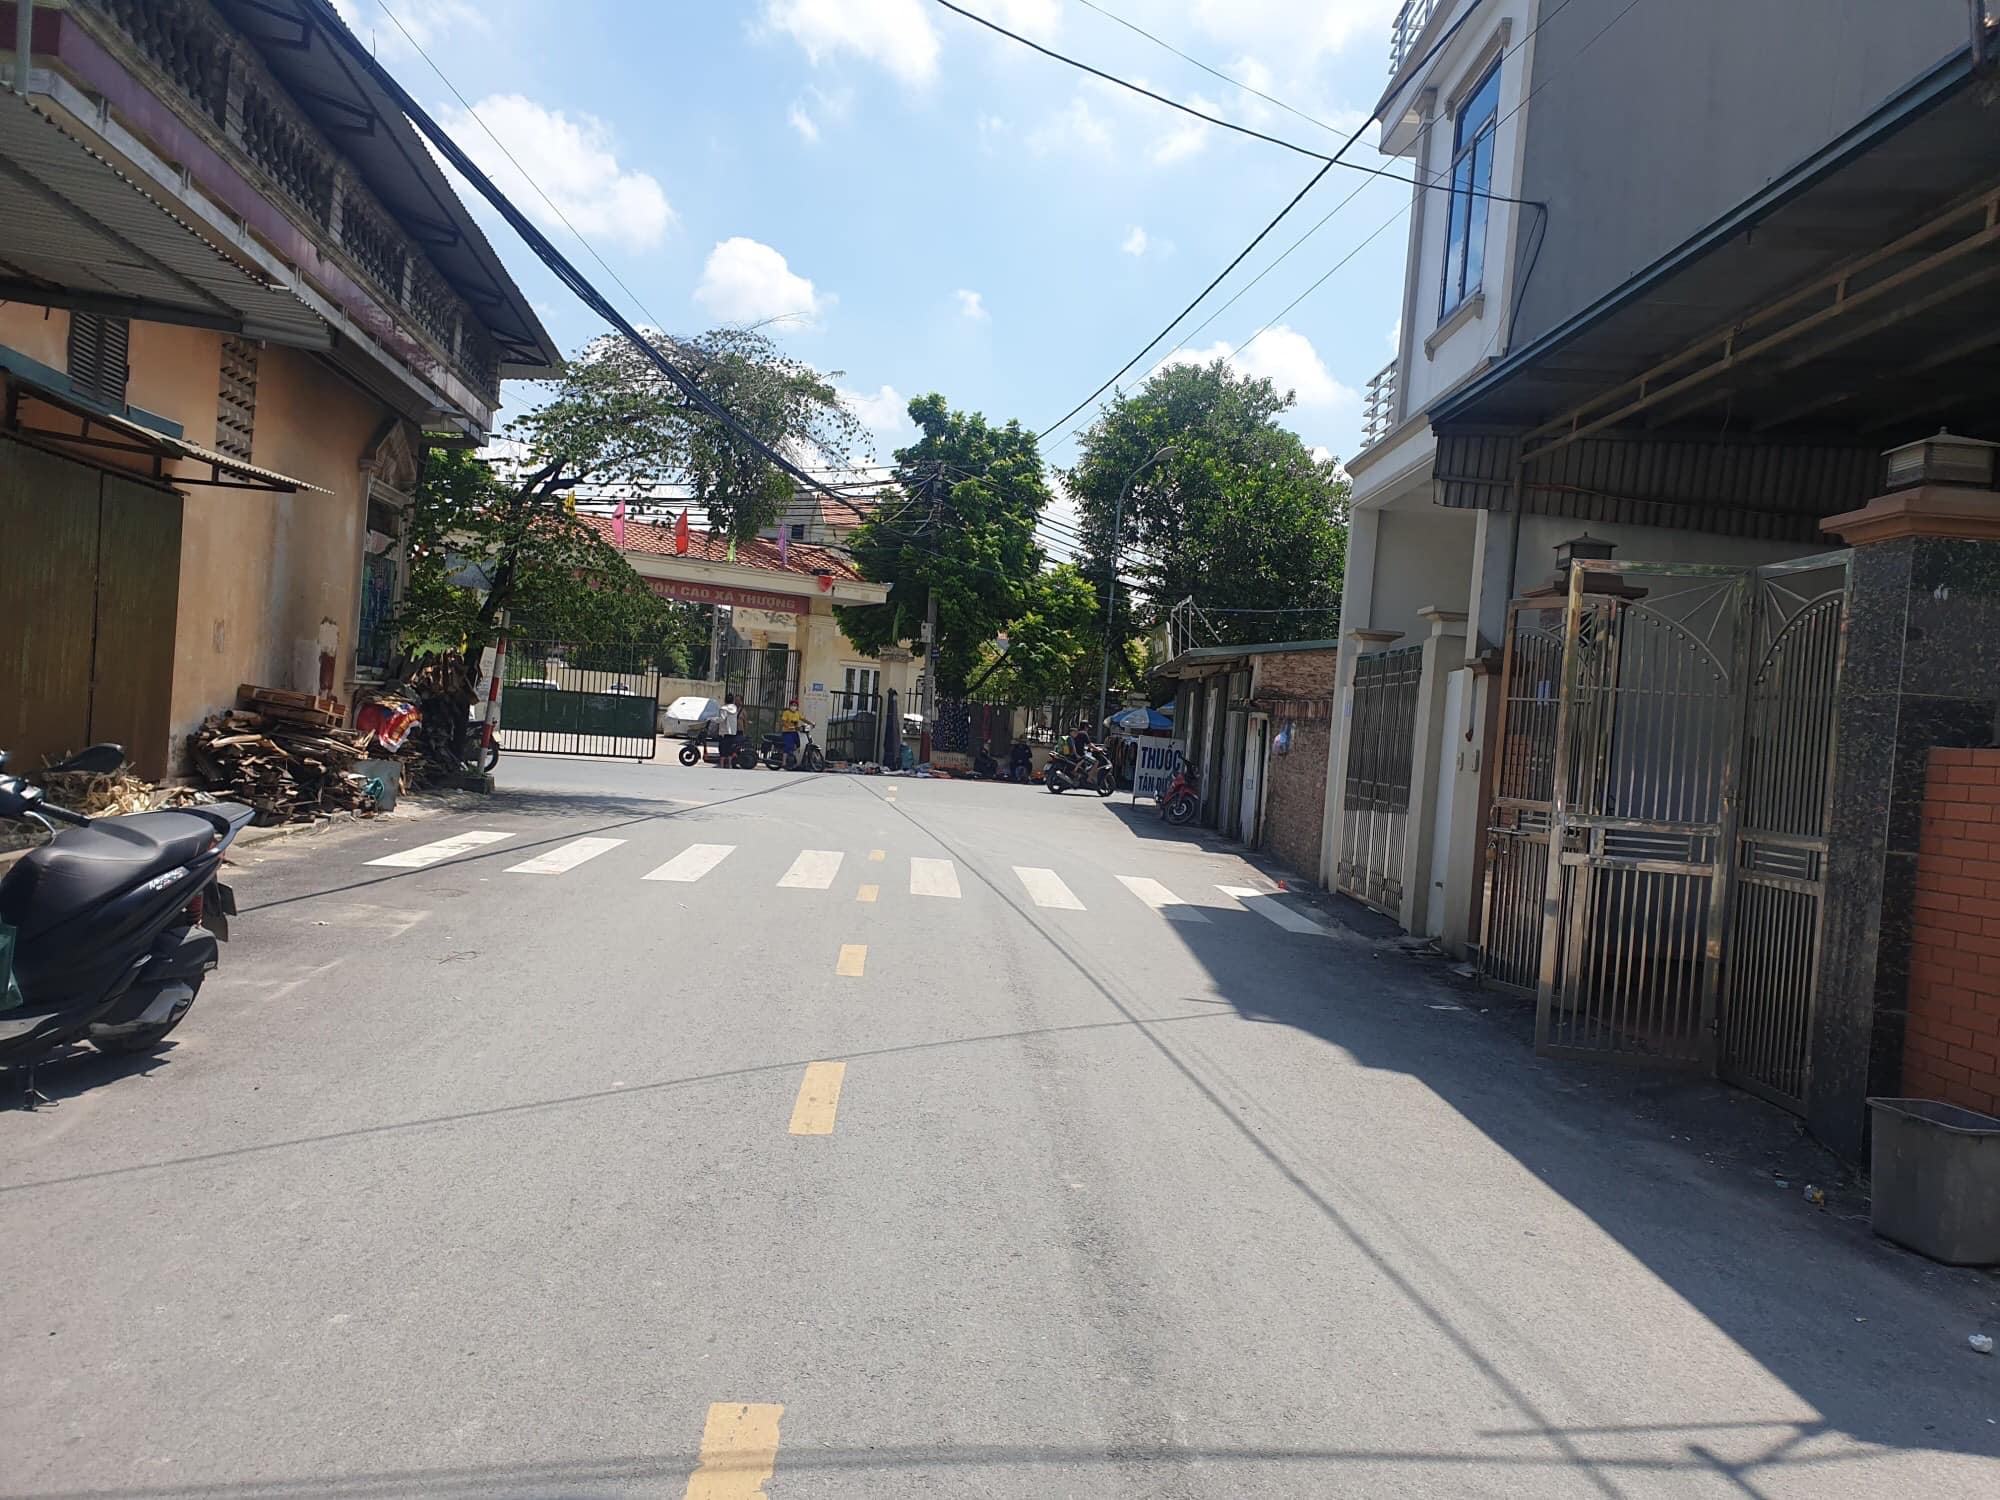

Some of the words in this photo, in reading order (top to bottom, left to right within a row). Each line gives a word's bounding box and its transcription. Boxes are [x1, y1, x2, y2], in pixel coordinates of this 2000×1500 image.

[680, 586, 710, 598] CAO
[1141, 742, 1182, 770] THUỐC
[1138, 773, 1155, 792] TÂN
